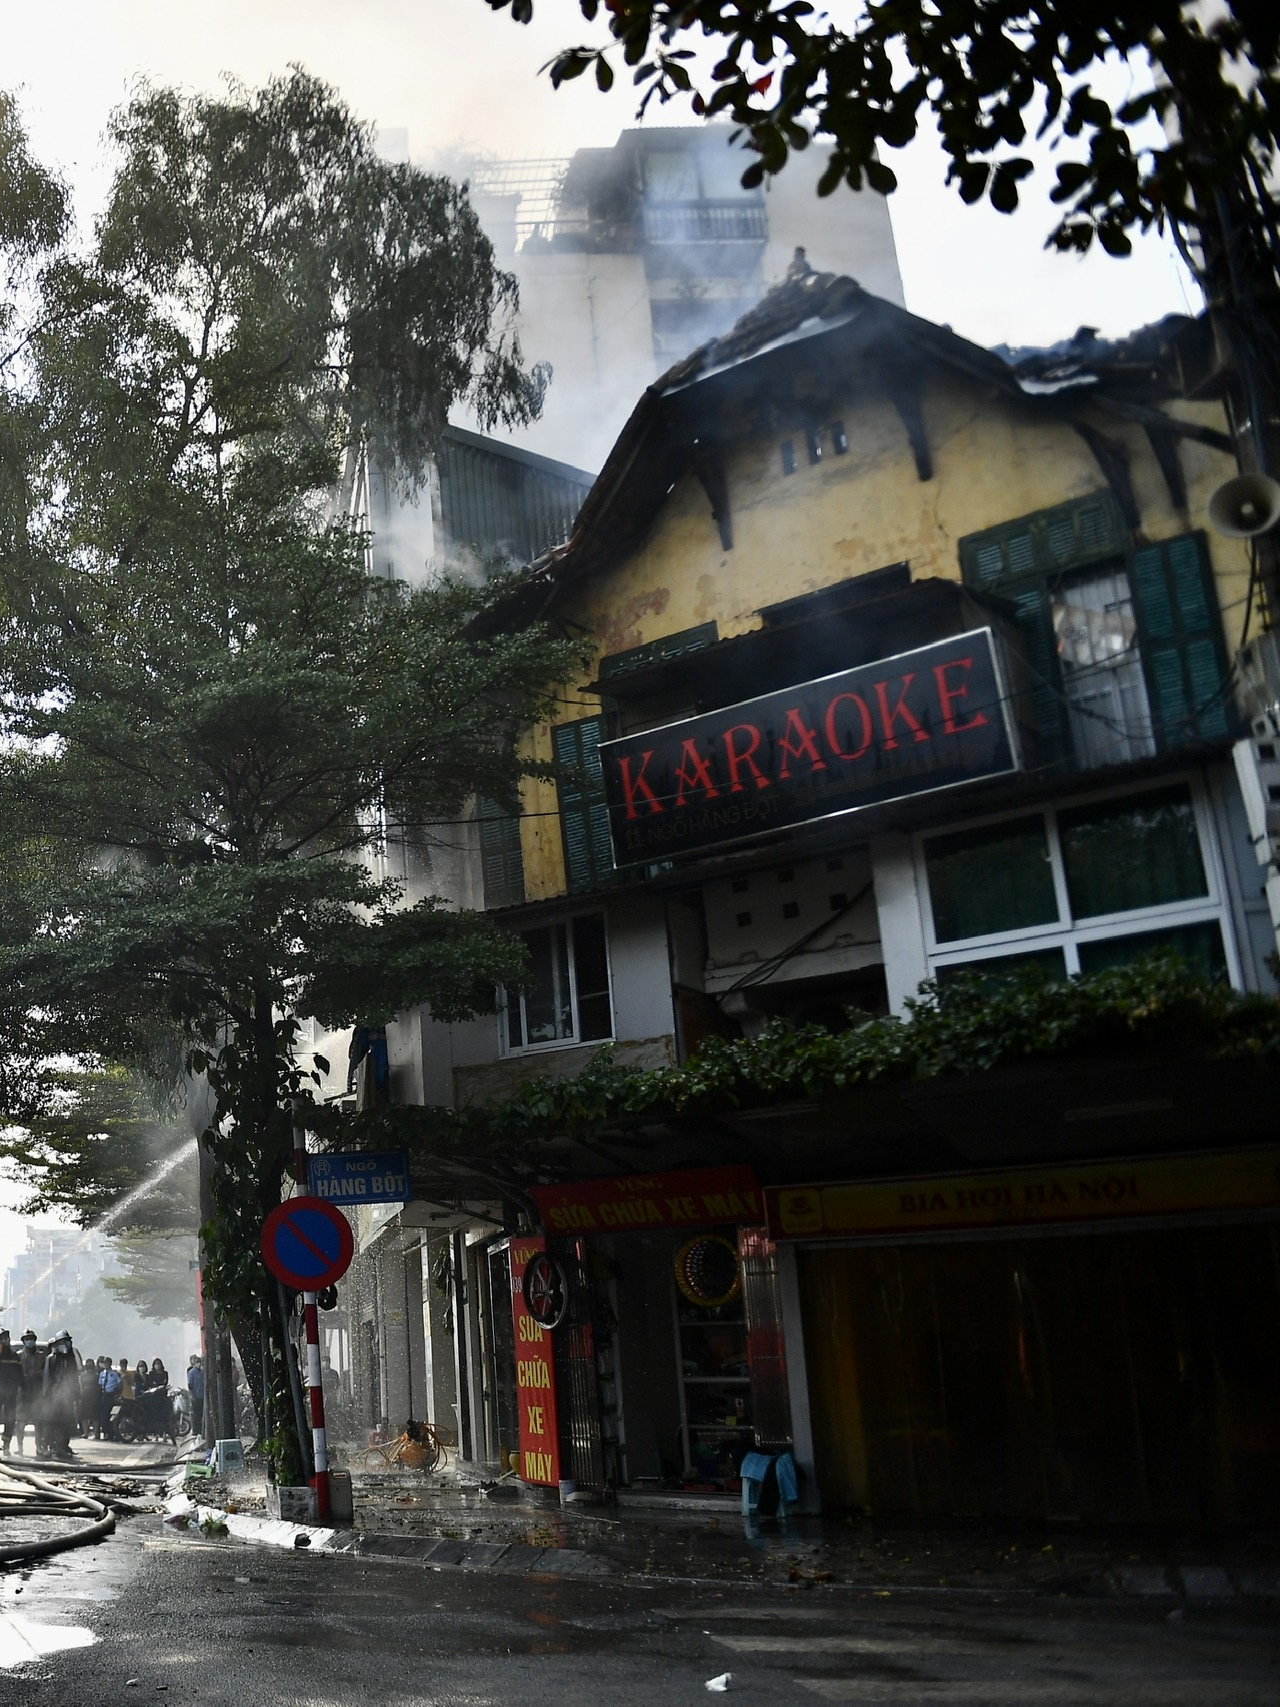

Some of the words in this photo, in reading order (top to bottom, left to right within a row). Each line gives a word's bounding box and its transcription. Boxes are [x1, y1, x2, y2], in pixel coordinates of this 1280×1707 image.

[617, 657, 989, 820] KARAOKE
[317, 1176, 366, 1197] HÀNG
[372, 1171, 405, 1197] BỘT
[346, 1160, 376, 1172] NGÕ
[548, 1196, 597, 1230] SỬA
[598, 1195, 666, 1227] CHỮA
[664, 1196, 701, 1221] XE
[702, 1186, 760, 1217] MÁY
[900, 1193, 948, 1213] BIA
[956, 1186, 1013, 1210] HƠI
[1023, 1179, 1068, 1205] HÀ
[1078, 1174, 1139, 1204] NỘI
[518, 1353, 551, 1389] CHỮA
[528, 1405, 545, 1435] XE
[525, 1446, 552, 1483] MÁY
